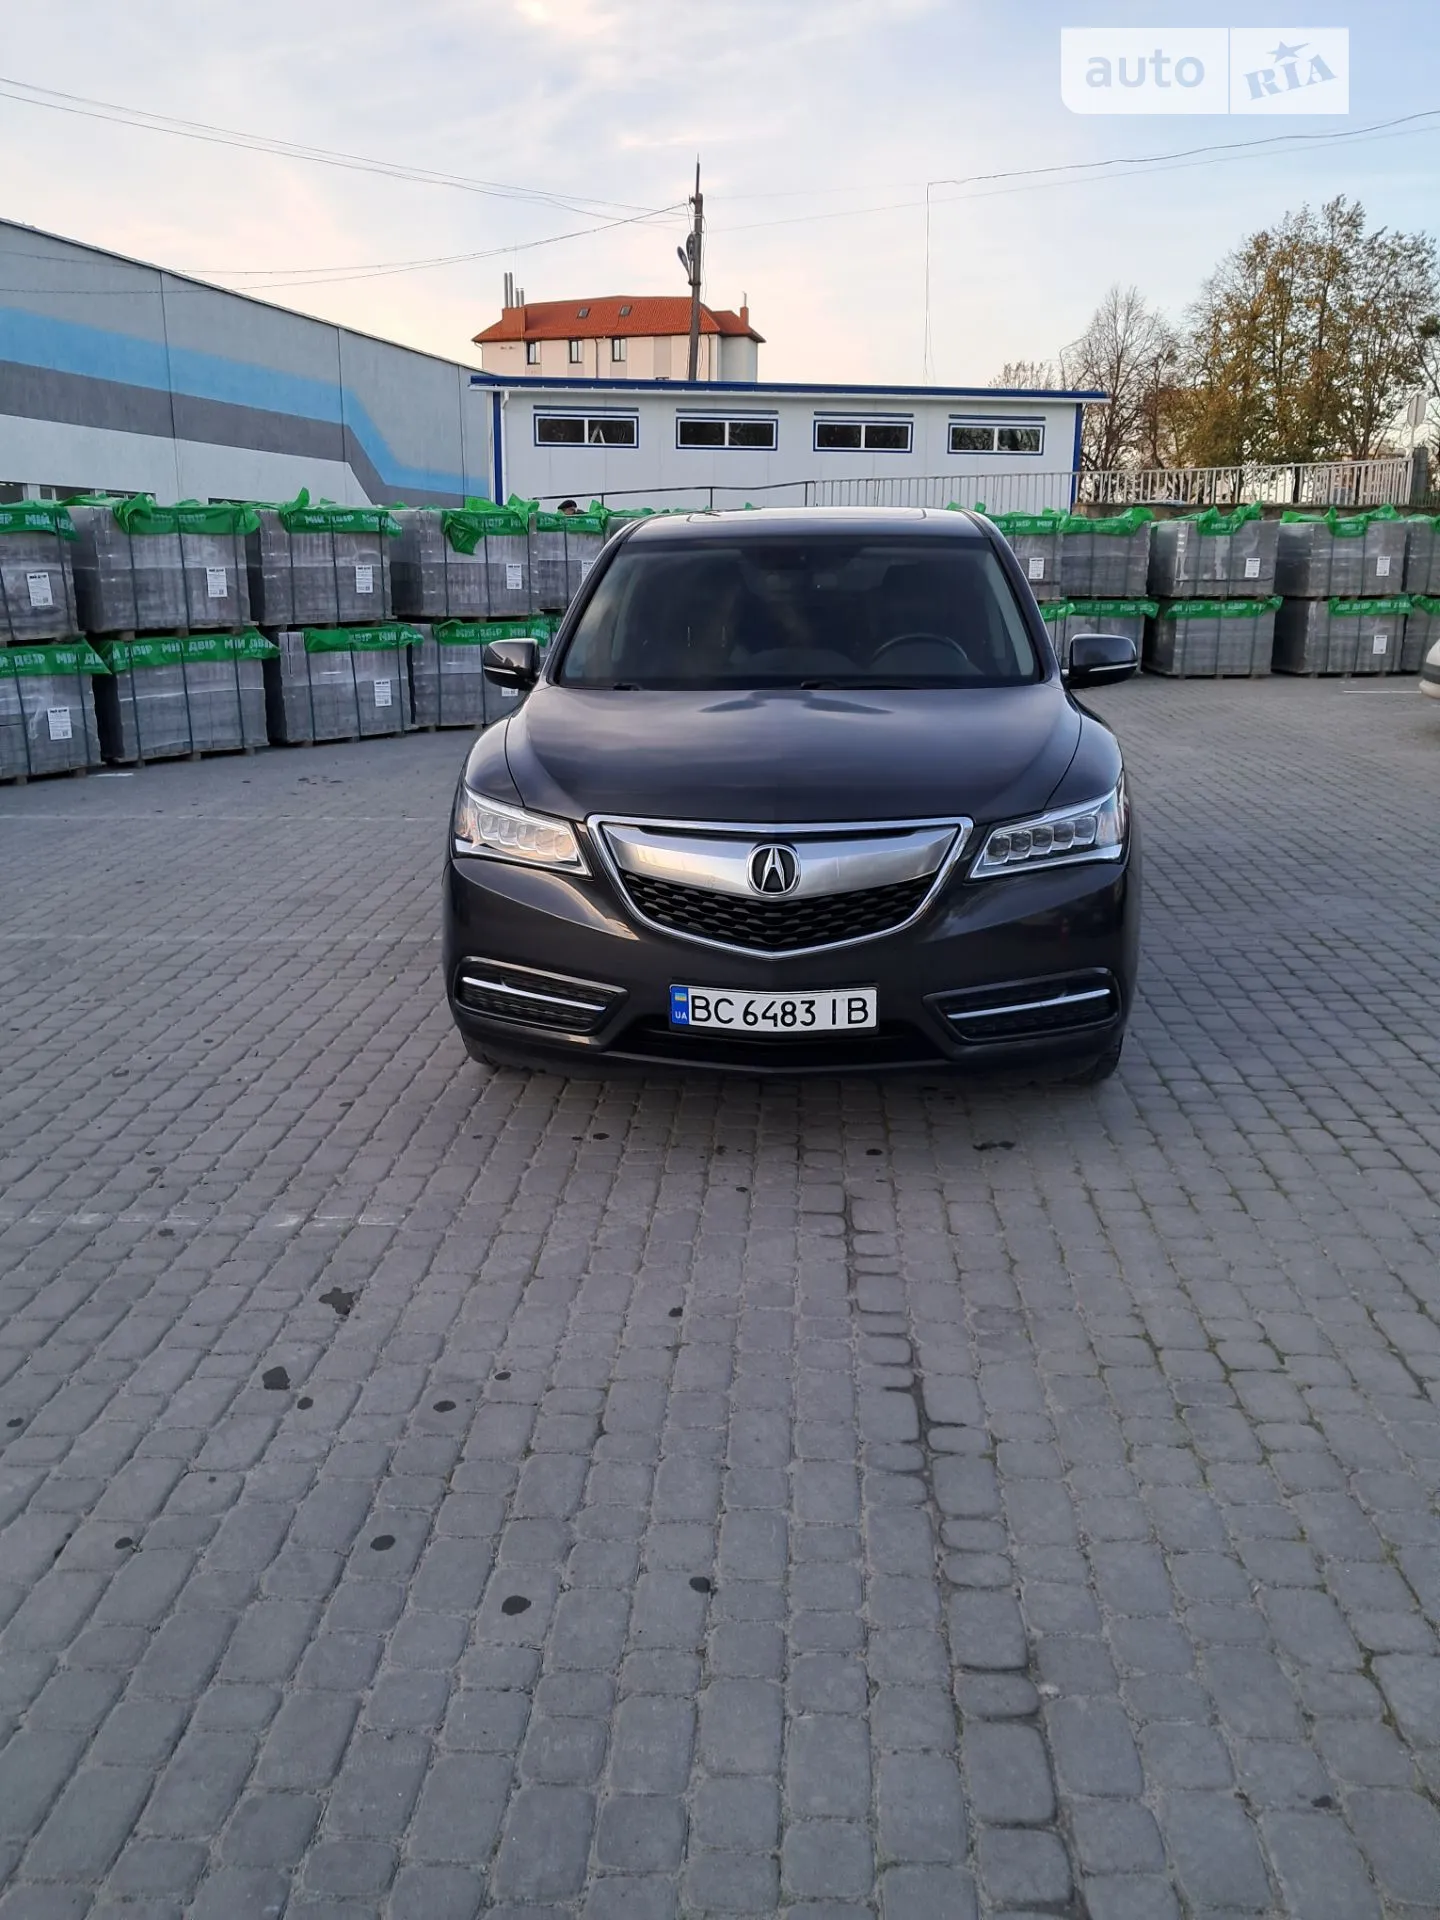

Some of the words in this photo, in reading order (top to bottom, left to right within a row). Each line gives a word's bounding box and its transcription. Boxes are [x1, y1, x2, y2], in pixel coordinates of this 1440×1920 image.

[675, 1010, 688, 1020] UA
[690, 995, 734, 1024] BC
[742, 1000, 816, 1027] 6483
[832, 997, 869, 1025] IB
